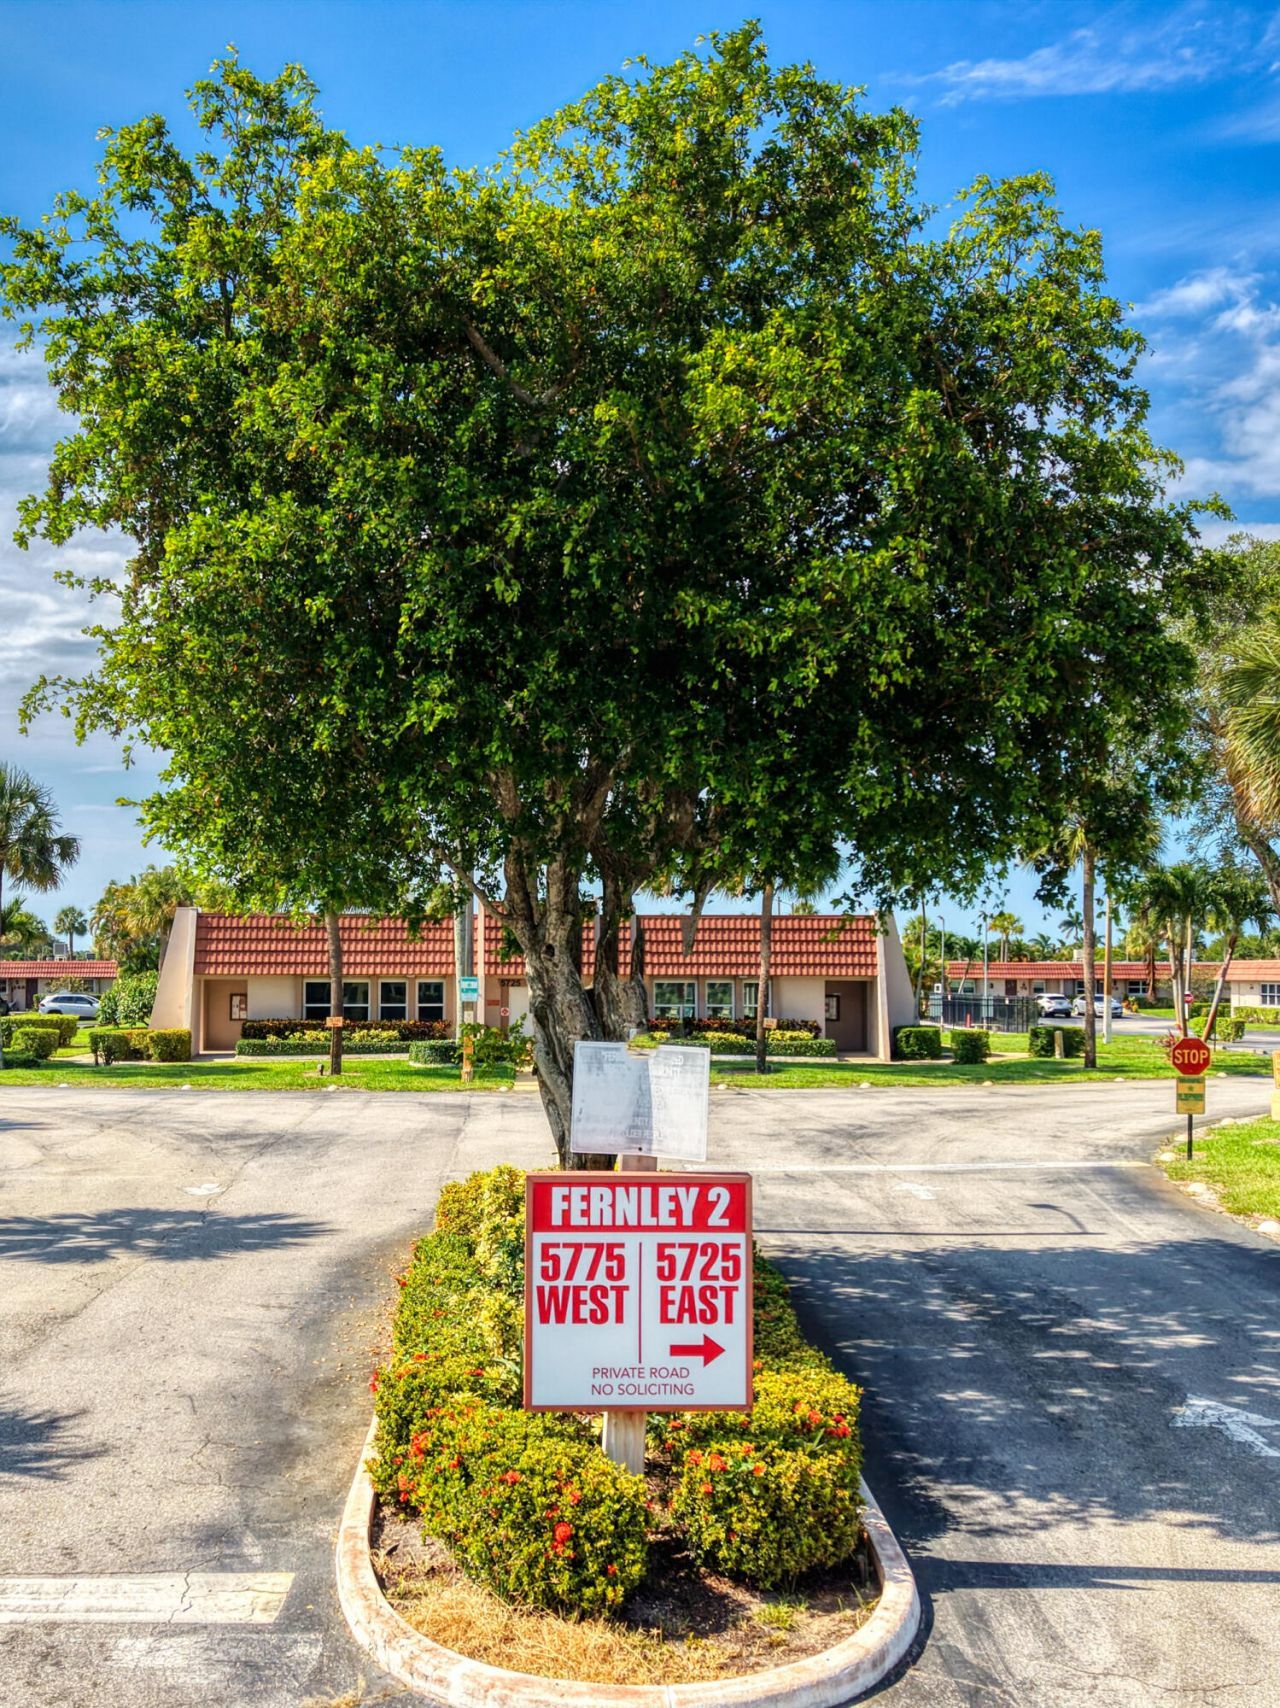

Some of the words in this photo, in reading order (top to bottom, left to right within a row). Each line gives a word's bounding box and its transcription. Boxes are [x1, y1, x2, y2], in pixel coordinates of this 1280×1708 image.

[1174, 1049, 1208, 1064] STOP
[551, 1186, 699, 1227] FERNLEY
[707, 1186, 731, 1227] 2
[540, 1242, 626, 1282] 5775
[656, 1242, 742, 1282] 5725
[536, 1285, 629, 1325] WEST
[659, 1285, 739, 1325] EAST
[591, 1383, 614, 1396] NO
[617, 1382, 695, 1396] SOLICITING
[592, 1367, 645, 1379] PRIVATE
[649, 1367, 690, 1379] ROAD
